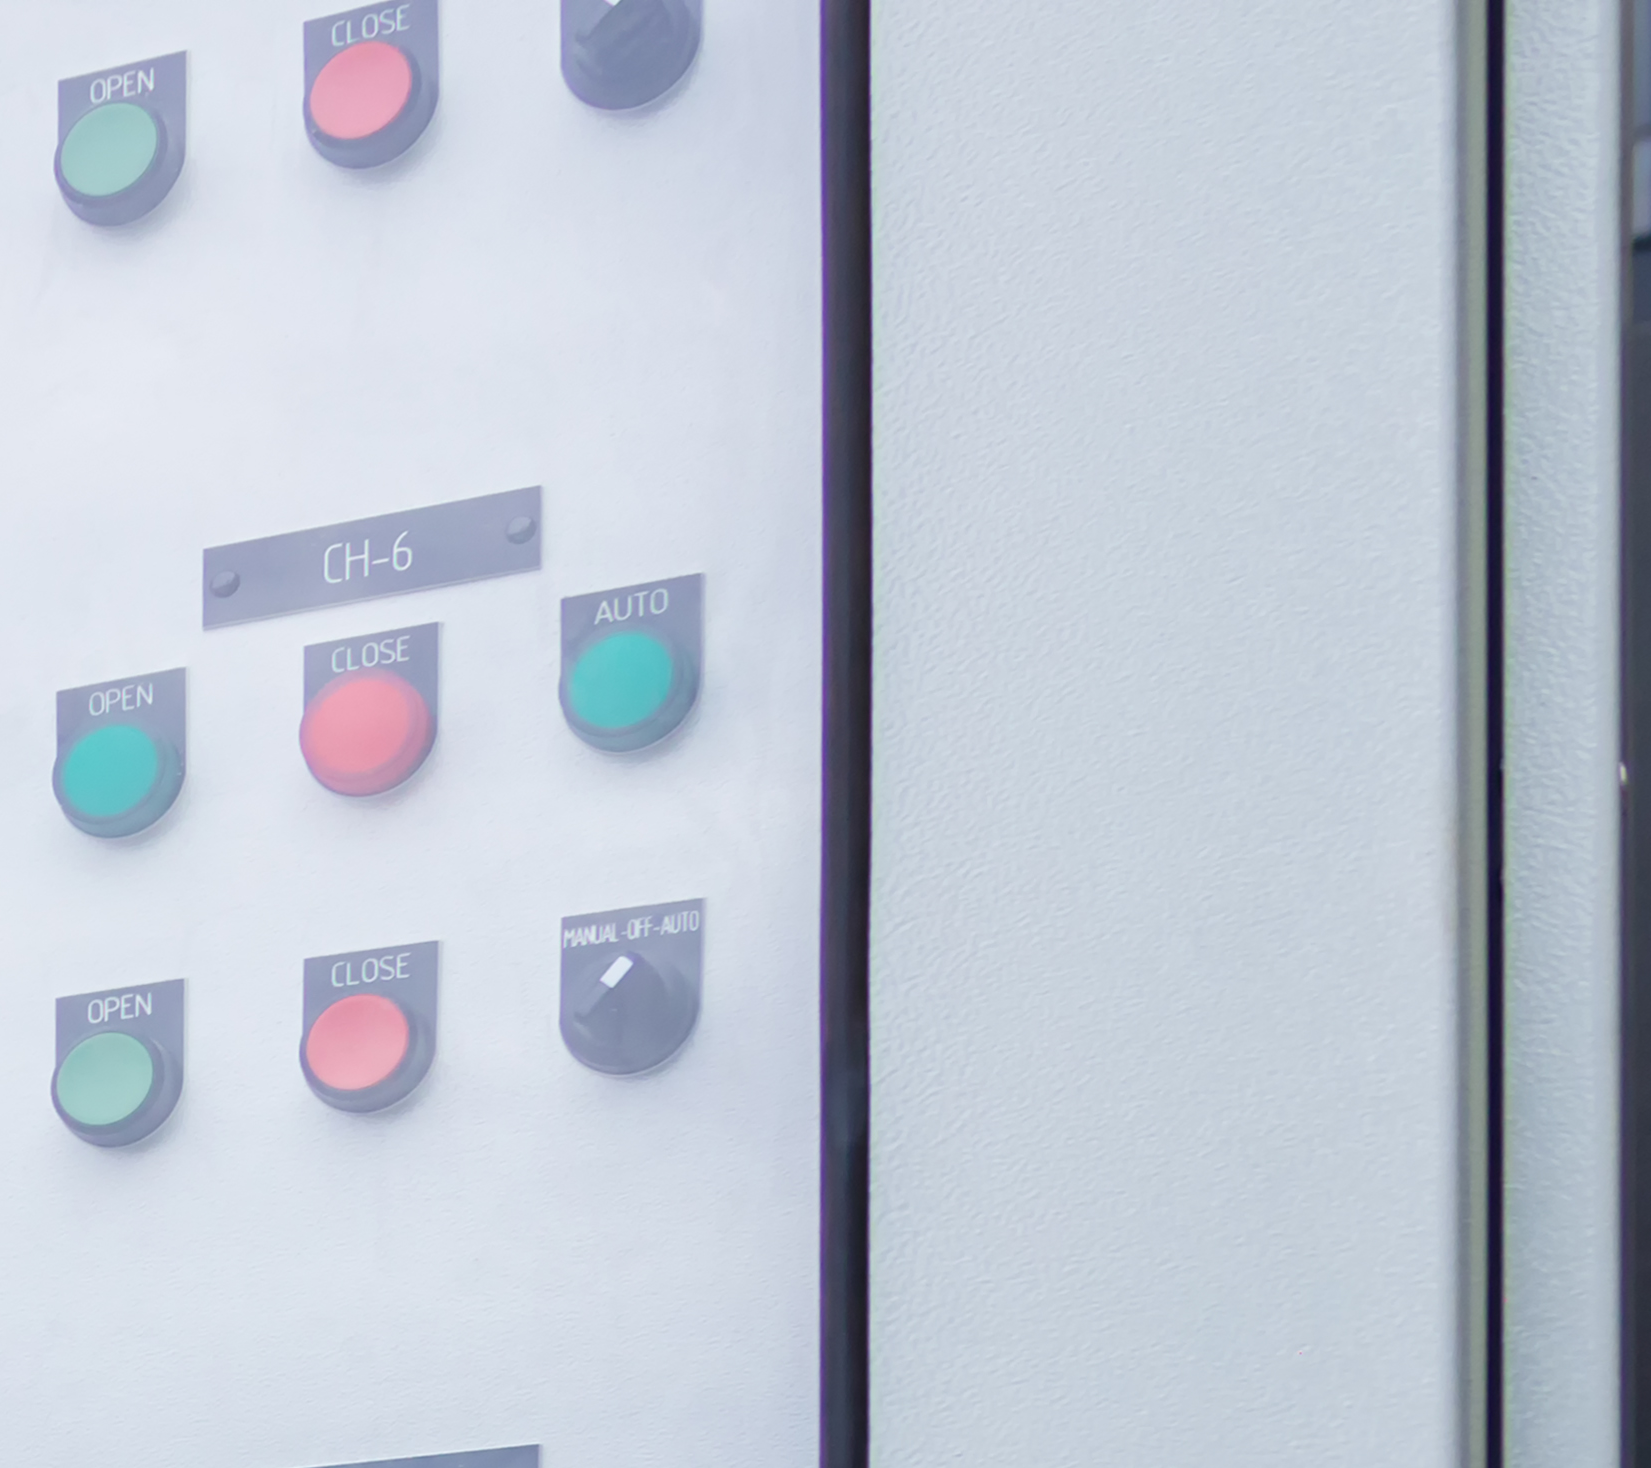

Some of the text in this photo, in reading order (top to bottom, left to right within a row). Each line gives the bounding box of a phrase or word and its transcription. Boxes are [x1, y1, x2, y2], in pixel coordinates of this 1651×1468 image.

[331, 3, 410, 47] CLOSE
[89, 67, 155, 105] OPEN
[323, 530, 413, 584] CH-6
[593, 588, 669, 625] AUTO
[331, 634, 411, 673] CLOSE
[88, 683, 154, 717] OPEN
[562, 910, 700, 949] MANUAL-OFF-AUTO
[331, 952, 411, 988] CLOSE
[87, 992, 152, 1024] OPEN
